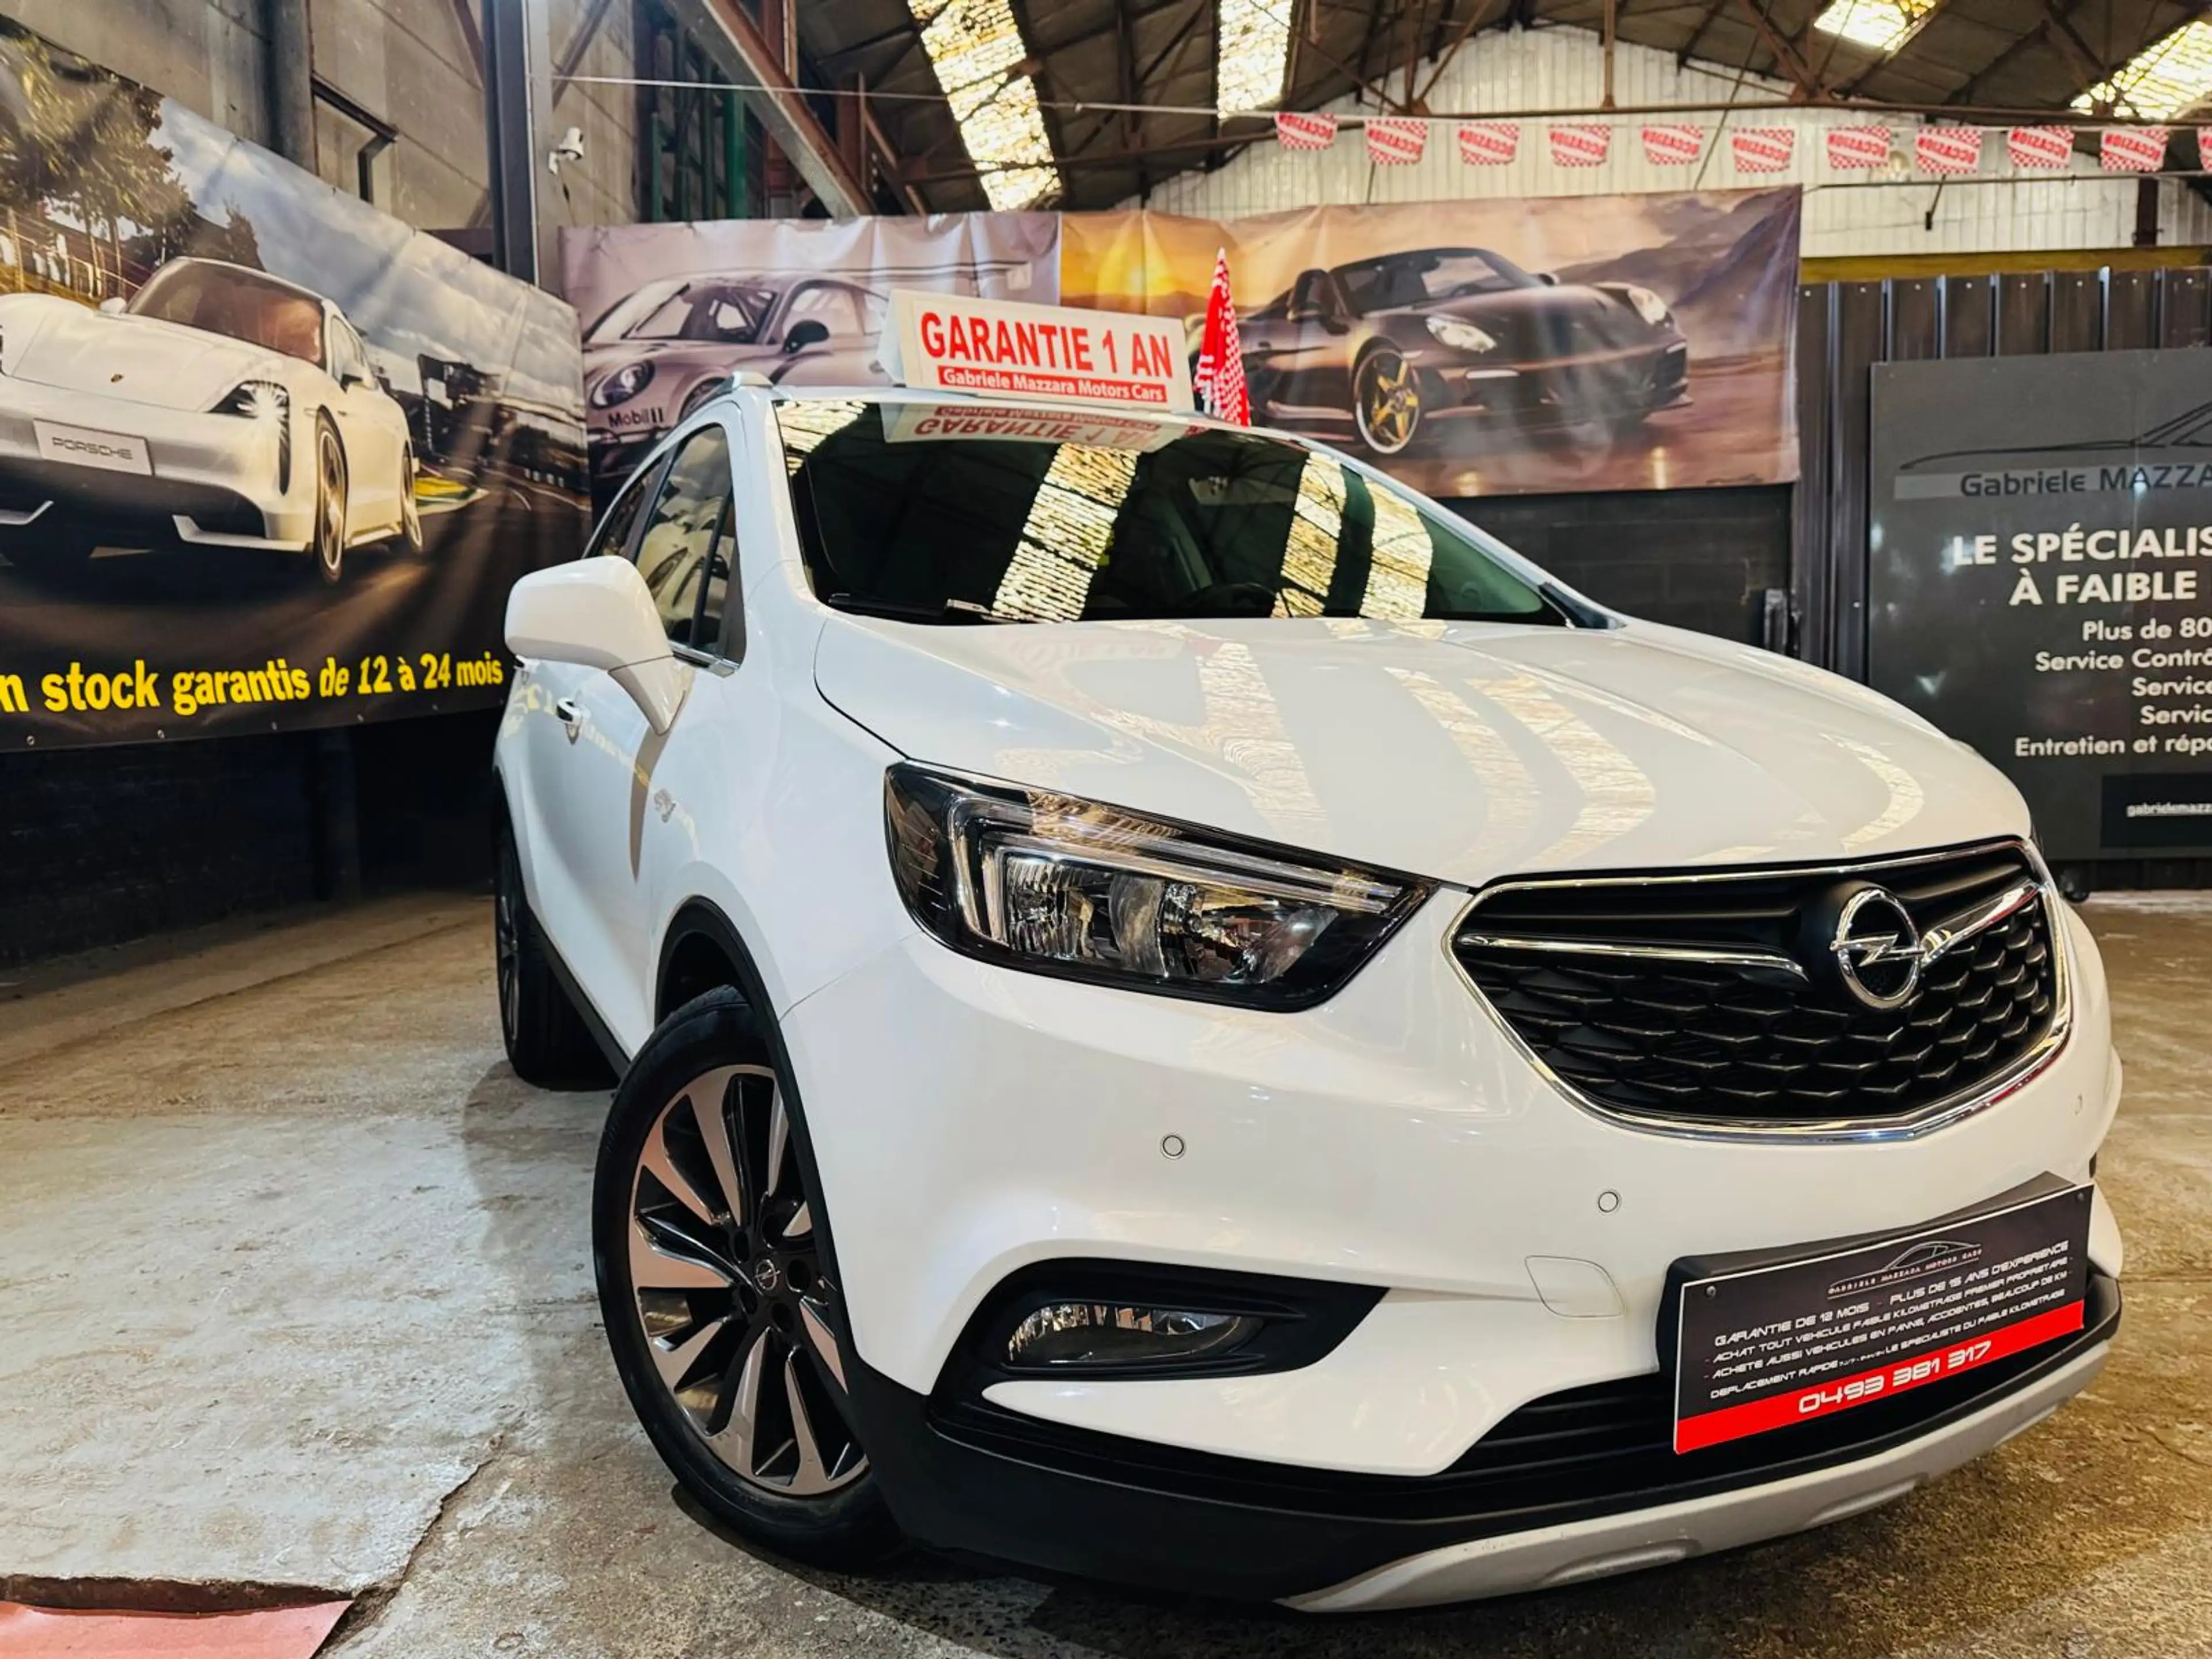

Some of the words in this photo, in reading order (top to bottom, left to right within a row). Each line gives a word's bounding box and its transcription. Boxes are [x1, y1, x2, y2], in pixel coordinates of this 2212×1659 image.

[922, 312, 1093, 372] GARANTIE
[1103, 329, 1118, 374] 1
[1132, 332, 1172, 378] AN
[944, 368, 1010, 389] Gabriele
[1013, 373, 1074, 395] Mazzara
[1078, 379, 1130, 399] Motors
[1132, 384, 1164, 402] Cars
[52, 437, 133, 460] PORSCHE
[1960, 469, 2086, 497] Gabriele
[1953, 535, 1997, 565] LE
[2009, 568, 2043, 605] À
[2056, 570, 2197, 604] FAIBLE
[2082, 620, 2133, 641] Plus
[2140, 618, 2172, 639] de
[2180, 617, 2212, 638] 80
[2035, 651, 2124, 672] Service
[44, 660, 161, 713] stock
[172, 658, 310, 715] garantis
[320, 657, 349, 698] de
[358, 655, 393, 694] 12
[397, 657, 416, 691] à
[420, 653, 452, 688] 24
[456, 650, 503, 686] mois
[2015, 736, 2125, 757] Entretien
[2133, 736, 2157, 753] et
[1713, 1359, 1763, 1379] ACHETE
[1766, 1350, 1802, 1366] AUSSI
[1805, 1335, 1868, 1356] VEHICULES
[1870, 1329, 1886, 1340] EN
[1991, 1281, 2040, 1303] BEAUCOUP
[2040, 1275, 2054, 1285] DE
[2054, 1270, 2068, 1281] KM
[1715, 1321, 1791, 1347] GARANTIE
[1796, 1315, 1816, 1329] DE
[1820, 1310, 1834, 1323] 12
[1837, 1302, 1870, 1319] MOIS
[1890, 1287, 1925, 1305] PLUS
[1928, 1281, 1946, 1294] DE
[1965, 1268, 1989, 1284] ANS
[1710, 1370, 1796, 1399] DEPLACEMENT
[1885, 1344, 1899, 1354] LE
[1963, 1319, 1976, 1329] DU
[1713, 1347, 1755, 1363] ACHAT
[1759, 1337, 1793, 1352] TOUT
[1796, 1324, 1850, 1344] VEHICULE
[1798, 1375, 1885, 1413] 0493
[1893, 1357, 1940, 1387] 381
[1948, 1340, 1991, 1369] 317
